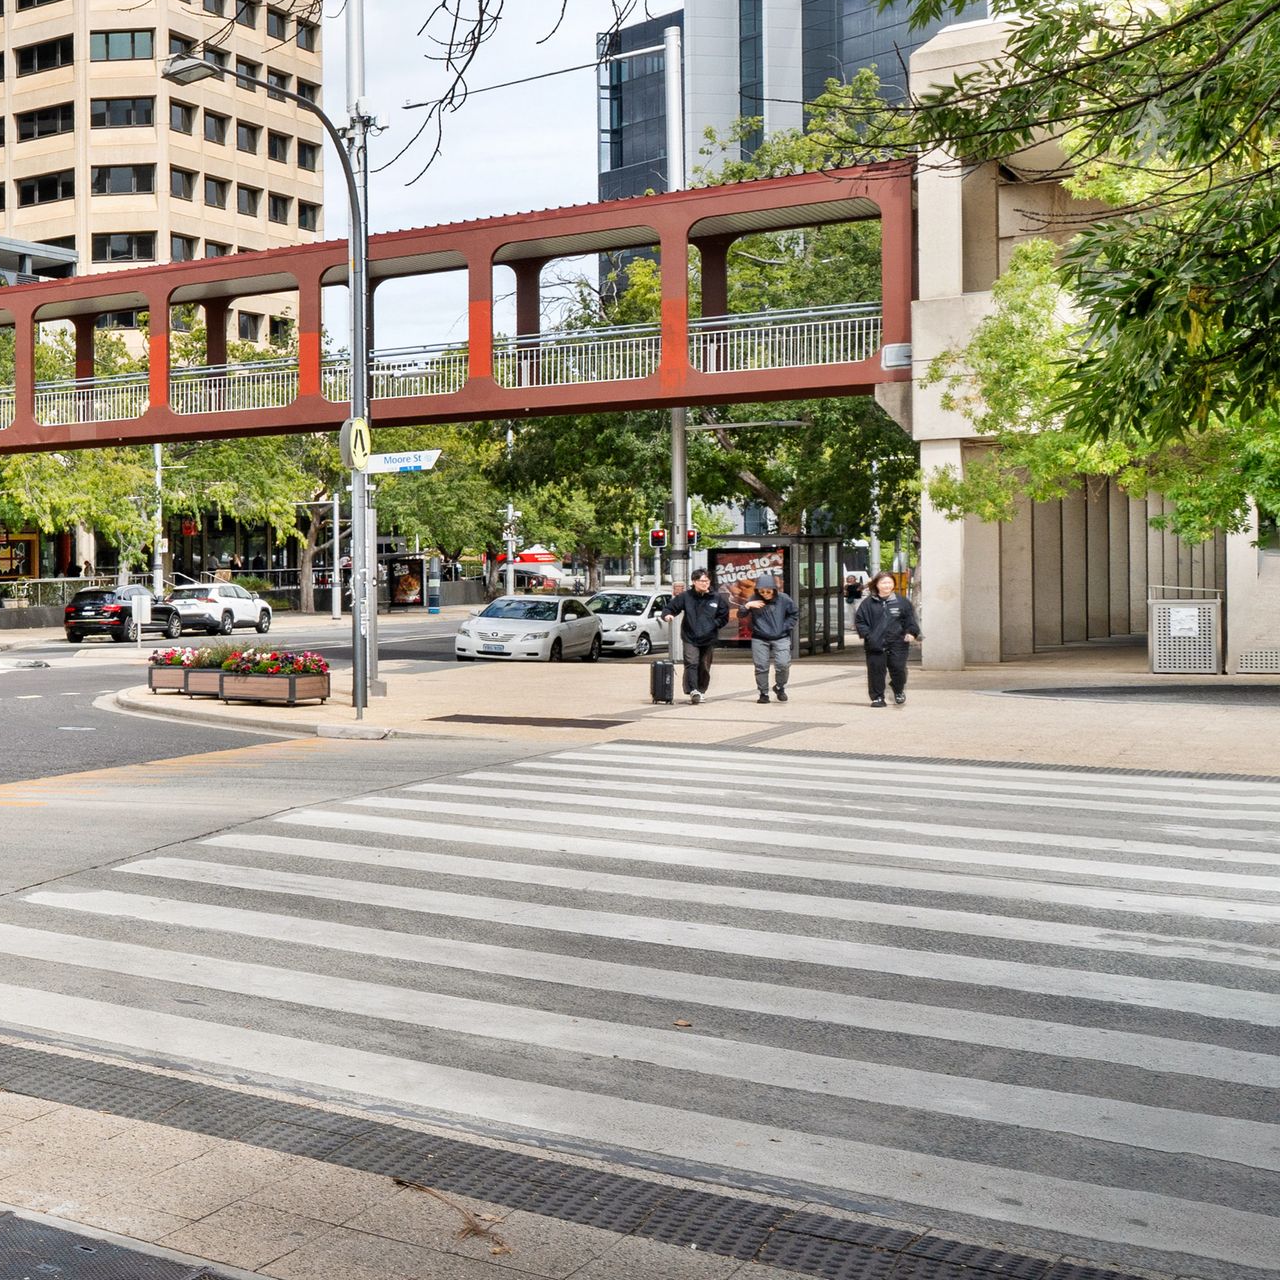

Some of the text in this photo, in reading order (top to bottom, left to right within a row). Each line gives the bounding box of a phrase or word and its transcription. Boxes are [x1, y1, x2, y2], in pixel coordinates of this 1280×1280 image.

[383, 454, 422, 464] Moore St
[715, 563, 734, 575] 24
[735, 564, 751, 572] FOR
[717, 566, 784, 584] NUGGETS
